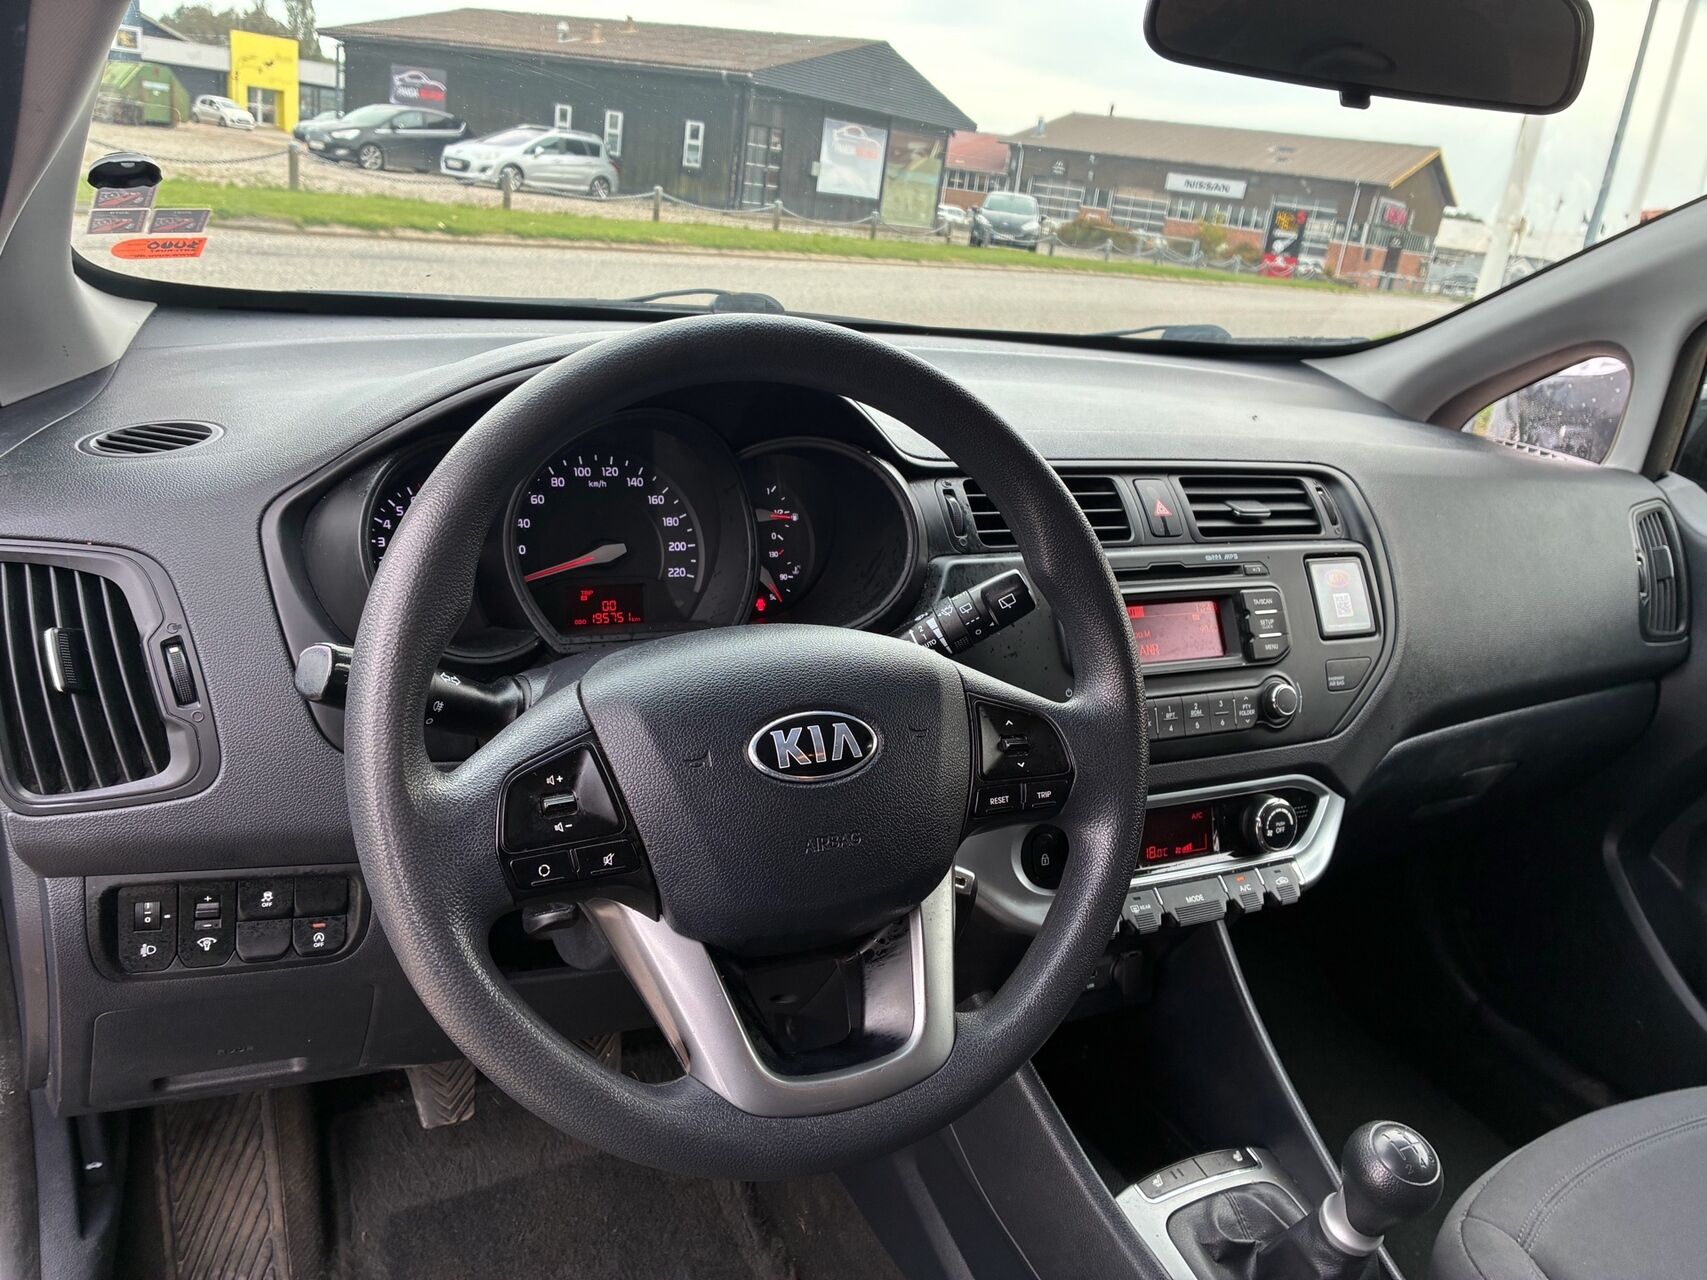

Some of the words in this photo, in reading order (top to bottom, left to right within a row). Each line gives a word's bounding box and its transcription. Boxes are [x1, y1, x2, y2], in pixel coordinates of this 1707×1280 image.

[1184, 179, 1231, 193] NISSAN
[573, 467, 591, 477] 100
[602, 467, 619, 477] 120
[551, 477, 565, 488] 80
[588, 480, 607, 488] km/h
[627, 477, 644, 487] 140
[530, 494, 545, 504] 60
[648, 495, 665, 505] 160
[395, 506, 404, 517] 5
[383, 519, 391, 530] 4
[517, 518, 531, 529] 40
[662, 516, 679, 526] 180
[771, 532, 776, 540] 0
[377, 537, 385, 547] 3
[668, 542, 687, 551] 200
[667, 567, 686, 577] 220
[921, 632, 928, 640] 1
[922, 639, 937, 648] UTO
[1193, 702, 1198, 710] 2
[1169, 724, 1173, 732] 4
[1195, 721, 1200, 729] 5
[1220, 719, 1225, 727] 6
[770, 722, 862, 769] KIA
[1037, 790, 1052, 800] TRIP
[989, 795, 1009, 806] RESET
[1192, 811, 1203, 820] A/C
[1275, 826, 1285, 834] OFF
[804, 832, 862, 854] AIRBAG
[1239, 884, 1251, 892] A/C
[1185, 894, 1204, 904] MODE
[1404, 1163, 1415, 1175] 2
